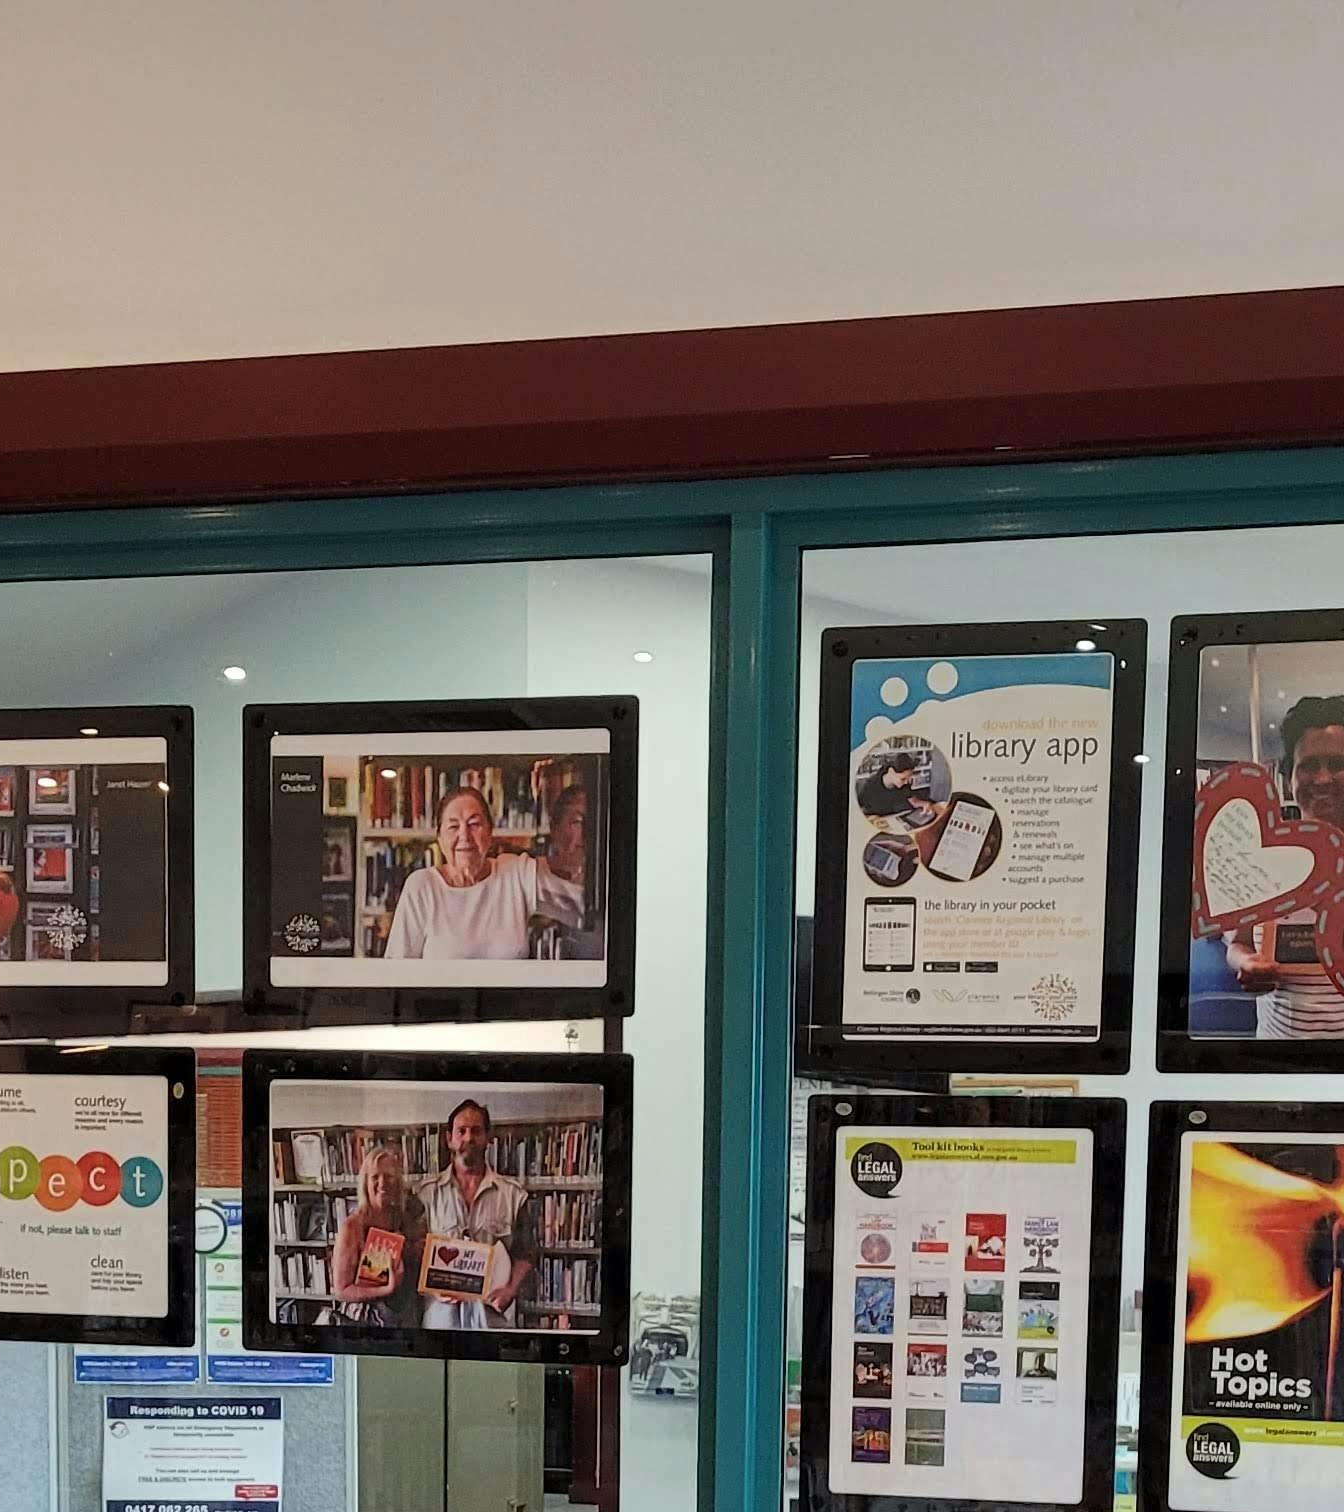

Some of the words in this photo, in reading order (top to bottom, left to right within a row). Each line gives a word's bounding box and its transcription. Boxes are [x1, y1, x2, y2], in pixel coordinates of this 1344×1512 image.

[951, 732, 1036, 764] library
[1046, 736, 1098, 763] app
[924, 900, 941, 910] the
[944, 900, 976, 912] library
[981, 901, 989, 910] in
[991, 902, 1016, 913] your
[1020, 900, 1056, 912] pocket
[75, 1095, 126, 1109] courtesy
[858, 1162, 897, 1174] LEGAL
[47, 1225, 73, 1236] please
[92, 1226, 101, 1236] to
[90, 1256, 124, 1269] clean
[0, 1267, 30, 1280] listen
[1211, 1347, 1268, 1373] Hot
[1211, 1371, 1312, 1400] Topics
[130, 1405, 194, 1418] Responding
[197, 1405, 209, 1416] to
[211, 1405, 248, 1416] COVID
[250, 1405, 264, 1416] 19
[1193, 1441, 1234, 1455] LEGAL
